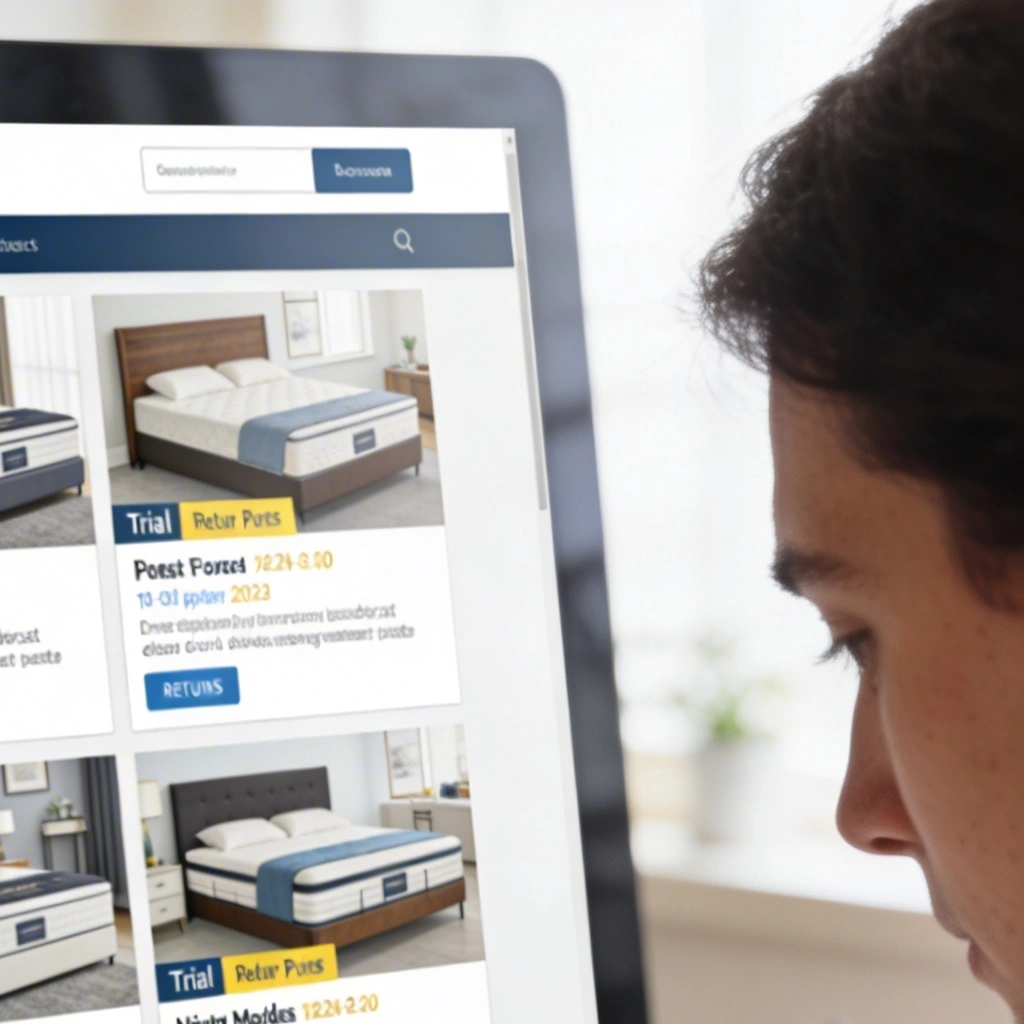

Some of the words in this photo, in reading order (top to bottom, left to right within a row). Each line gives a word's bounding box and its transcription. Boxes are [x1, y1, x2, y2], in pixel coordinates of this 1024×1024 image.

[127, 511, 172, 535] Trial
[230, 584, 271, 603] 2023
[168, 964, 214, 992] Trial
